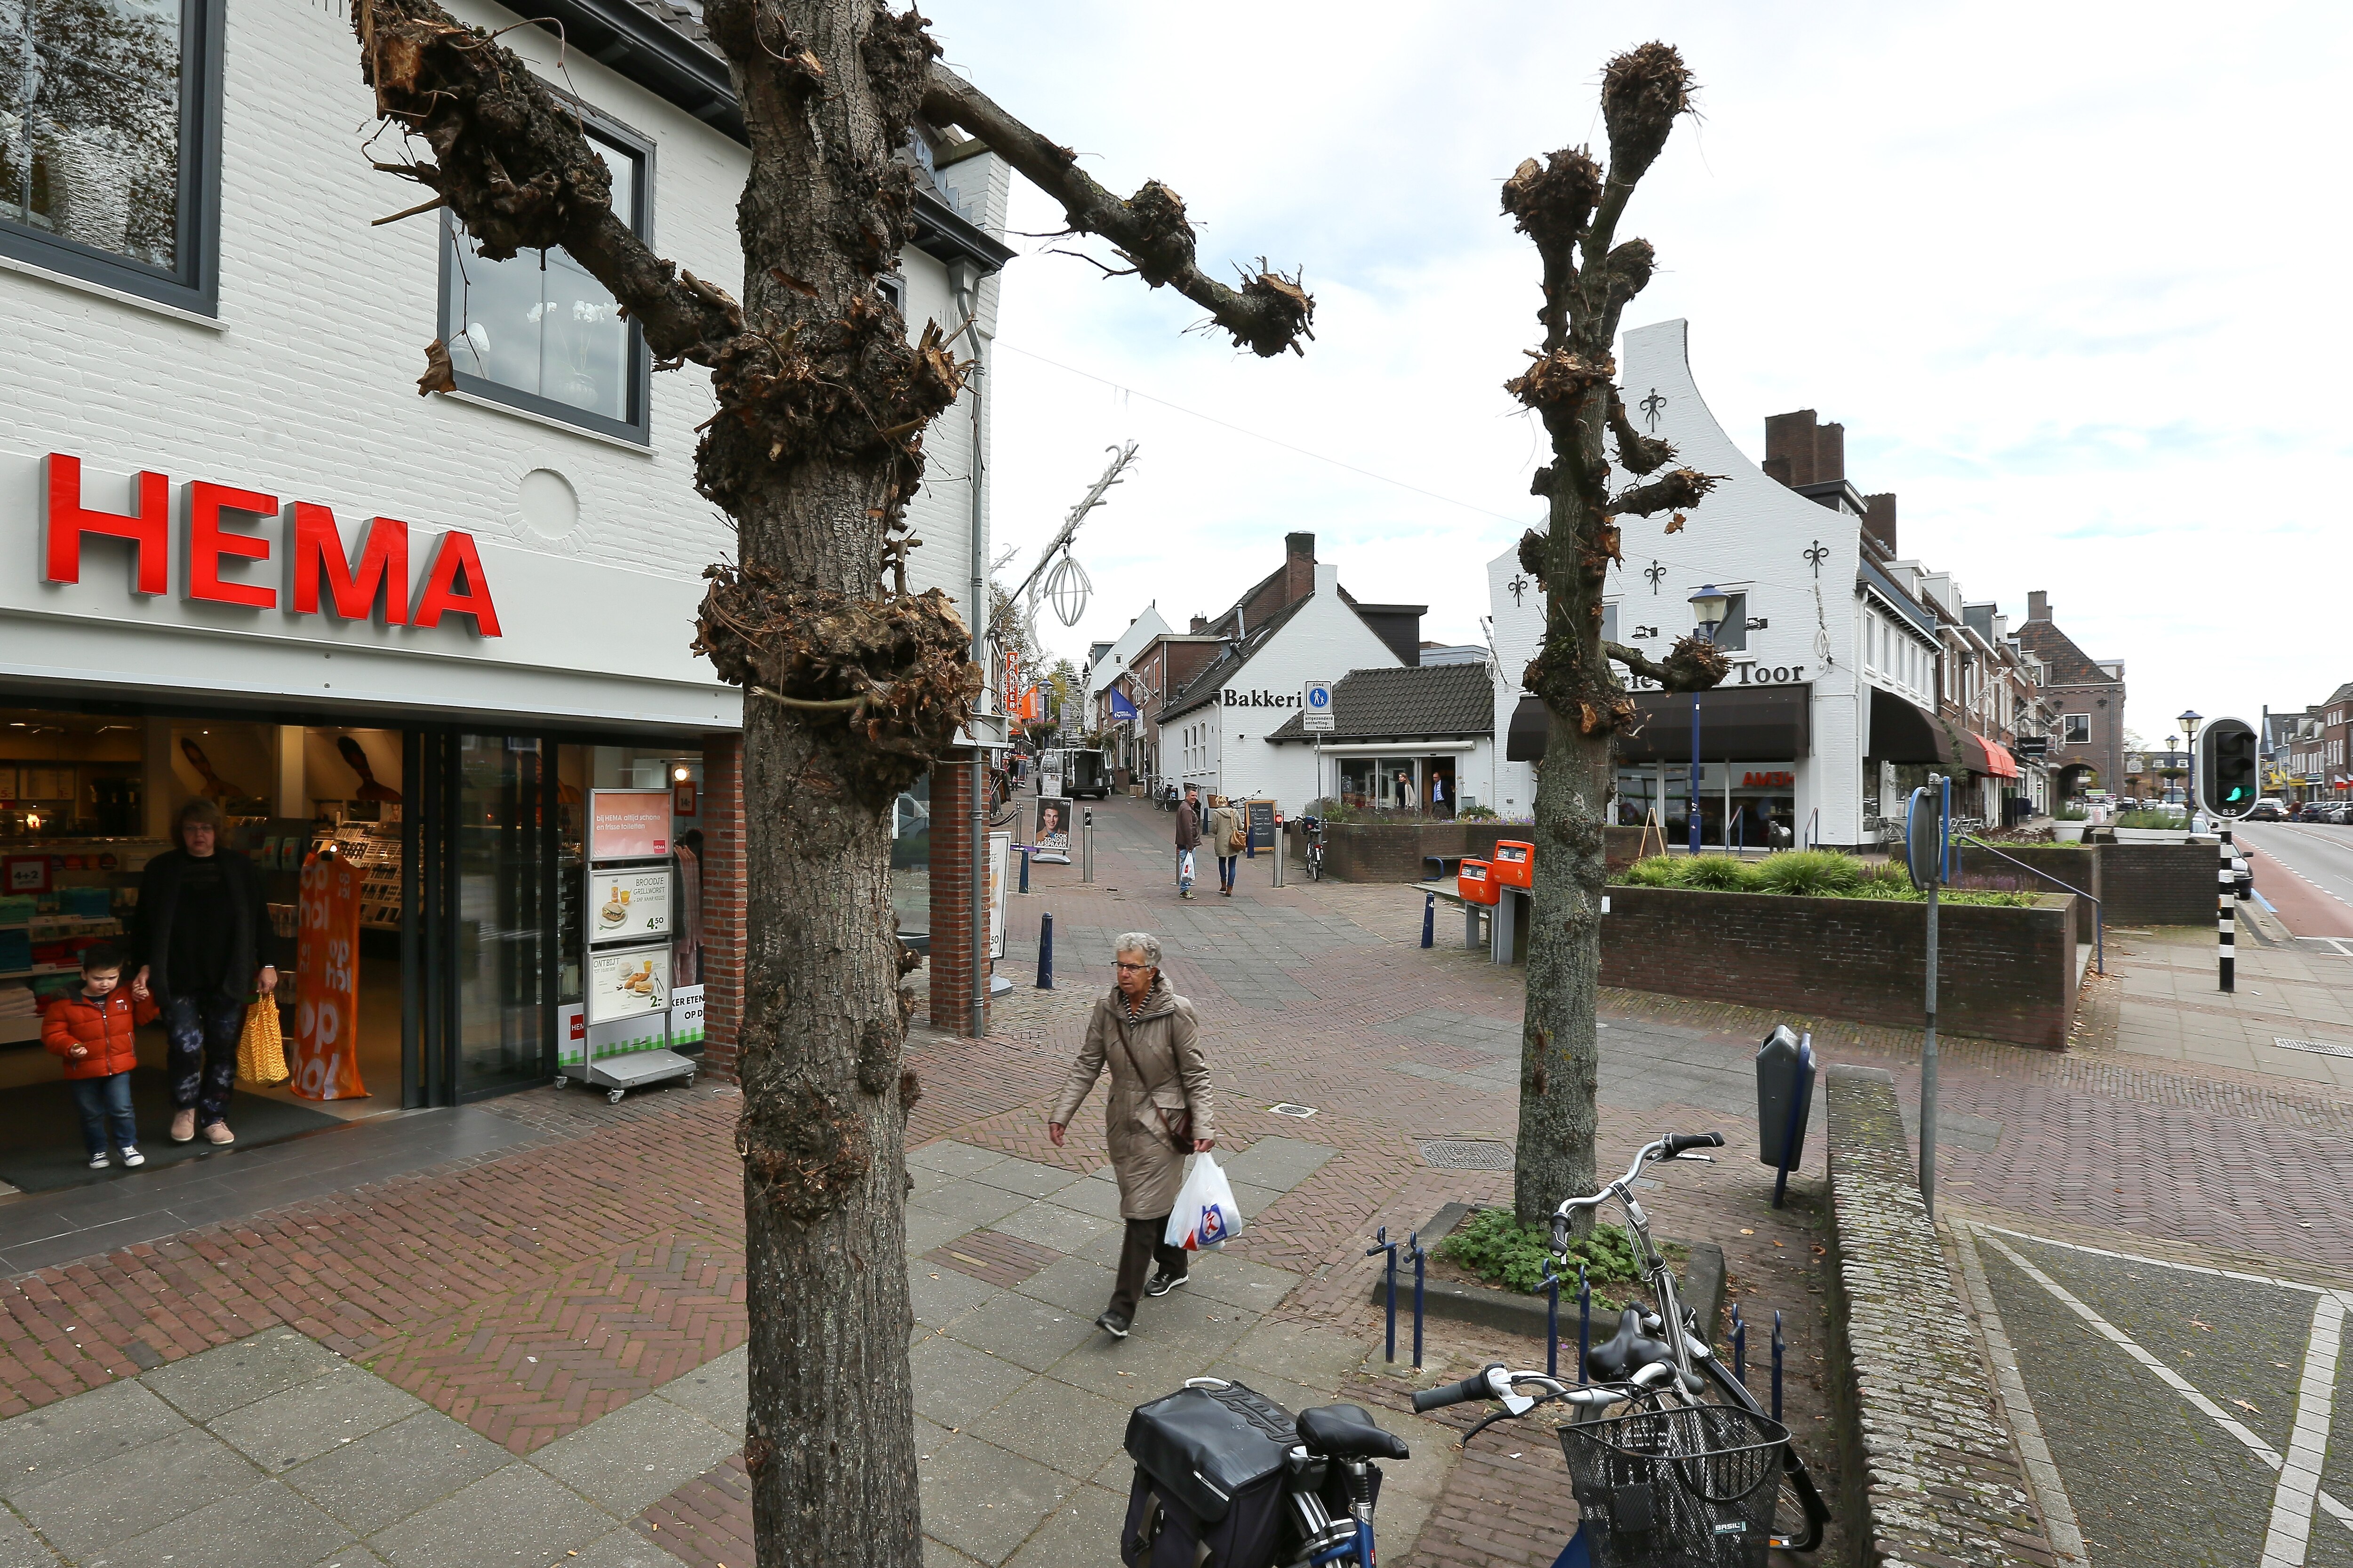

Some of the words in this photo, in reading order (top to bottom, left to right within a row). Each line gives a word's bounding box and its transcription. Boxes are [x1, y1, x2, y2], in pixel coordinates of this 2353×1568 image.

[39, 452, 502, 638] HEMA
[1733, 662, 1803, 684] Toor
[1224, 689, 1302, 708] Bakkeri
[636, 877, 664, 886] BROODJE
[633, 887, 665, 895] GRILLWORST
[329, 939, 350, 968] op
[593, 958, 620, 968] ONTBIJT
[326, 960, 352, 993] hol
[685, 1010, 696, 1019] OP
[1715, 1522, 1740, 1530] BASIL
